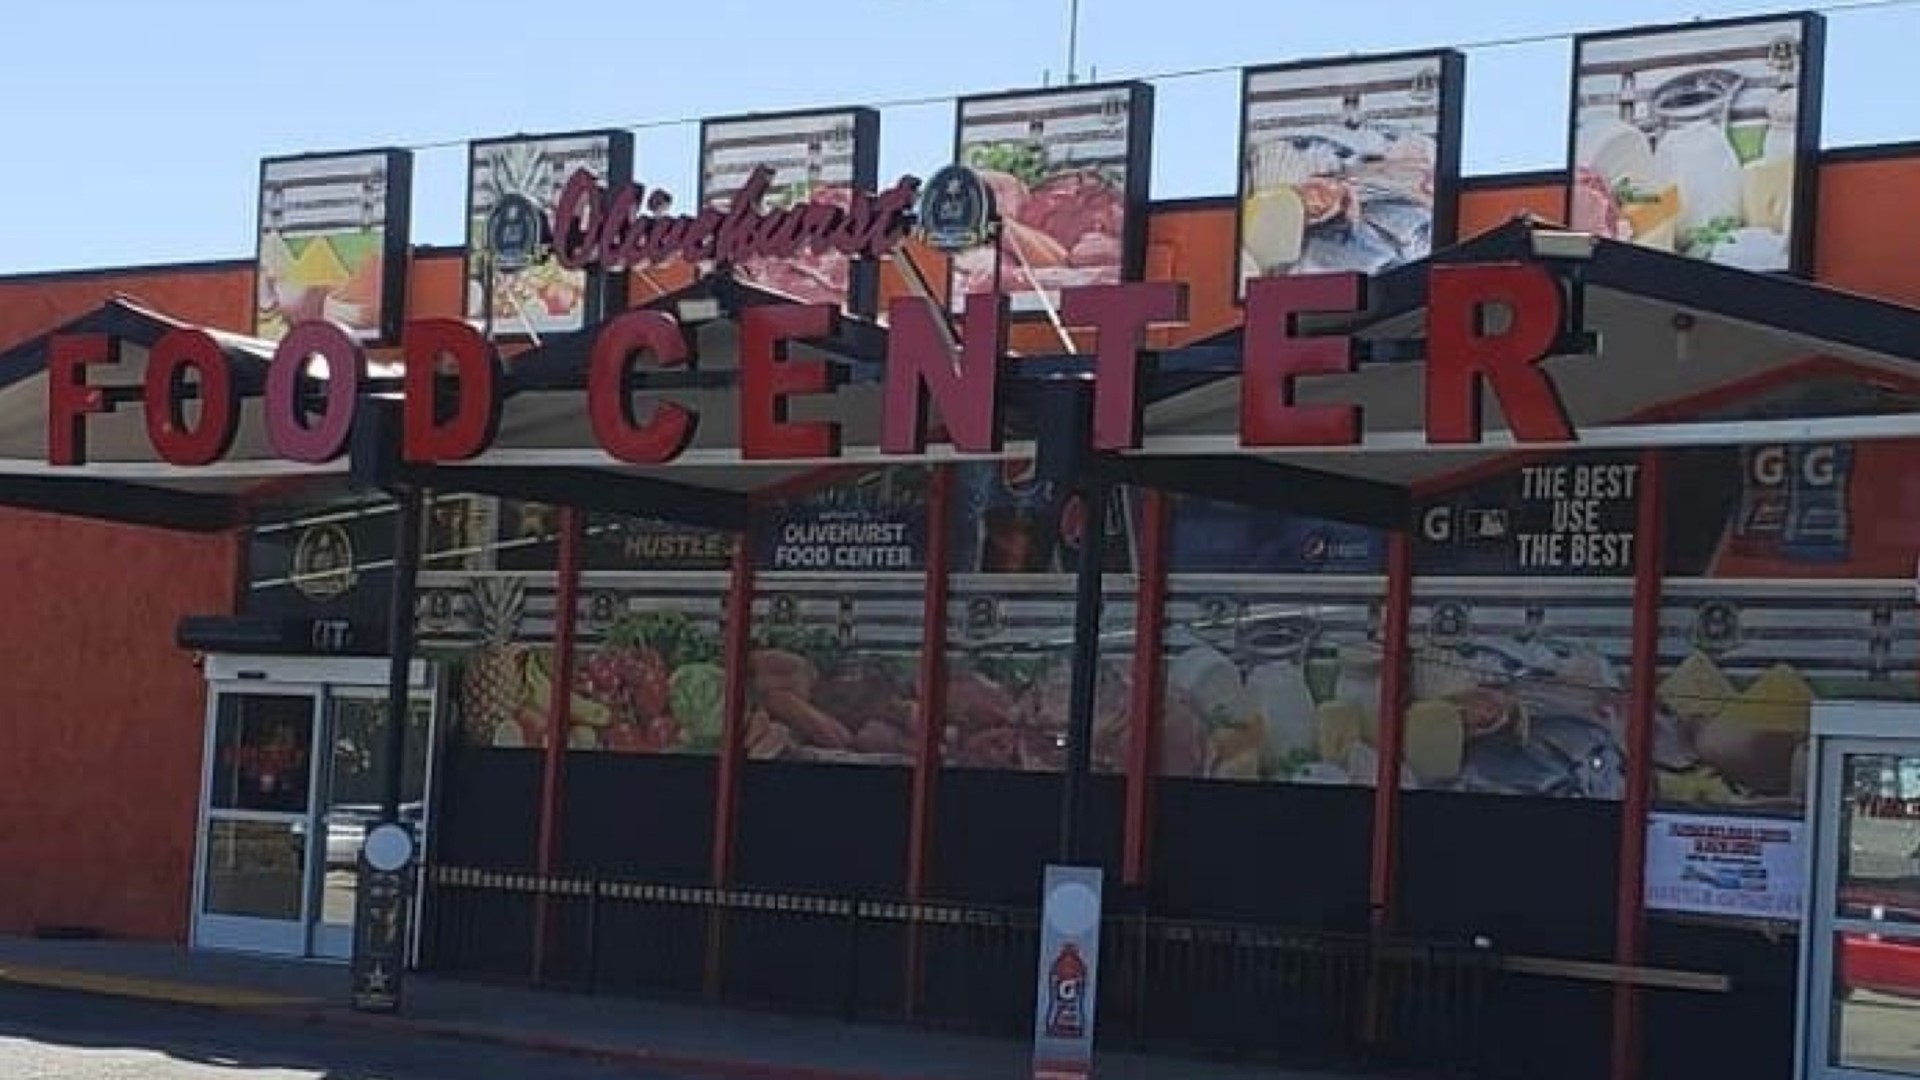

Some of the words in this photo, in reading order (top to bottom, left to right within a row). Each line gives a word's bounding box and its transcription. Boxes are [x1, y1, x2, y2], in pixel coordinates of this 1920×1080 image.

[553, 166, 922, 270] Olivehurst
[47, 317, 502, 467] FOOD
[587, 262, 1578, 465] CENTER
[1521, 467, 1565, 500] THE
[1574, 465, 1639, 499] BEST
[784, 522, 907, 544] OLIVEHURST
[1423, 506, 1451, 541] G
[1552, 500, 1600, 532] USE
[774, 545, 831, 567] FOOD
[835, 545, 912, 567] CENTER
[1517, 534, 1563, 567] THE
[1571, 534, 1634, 567] BEST
